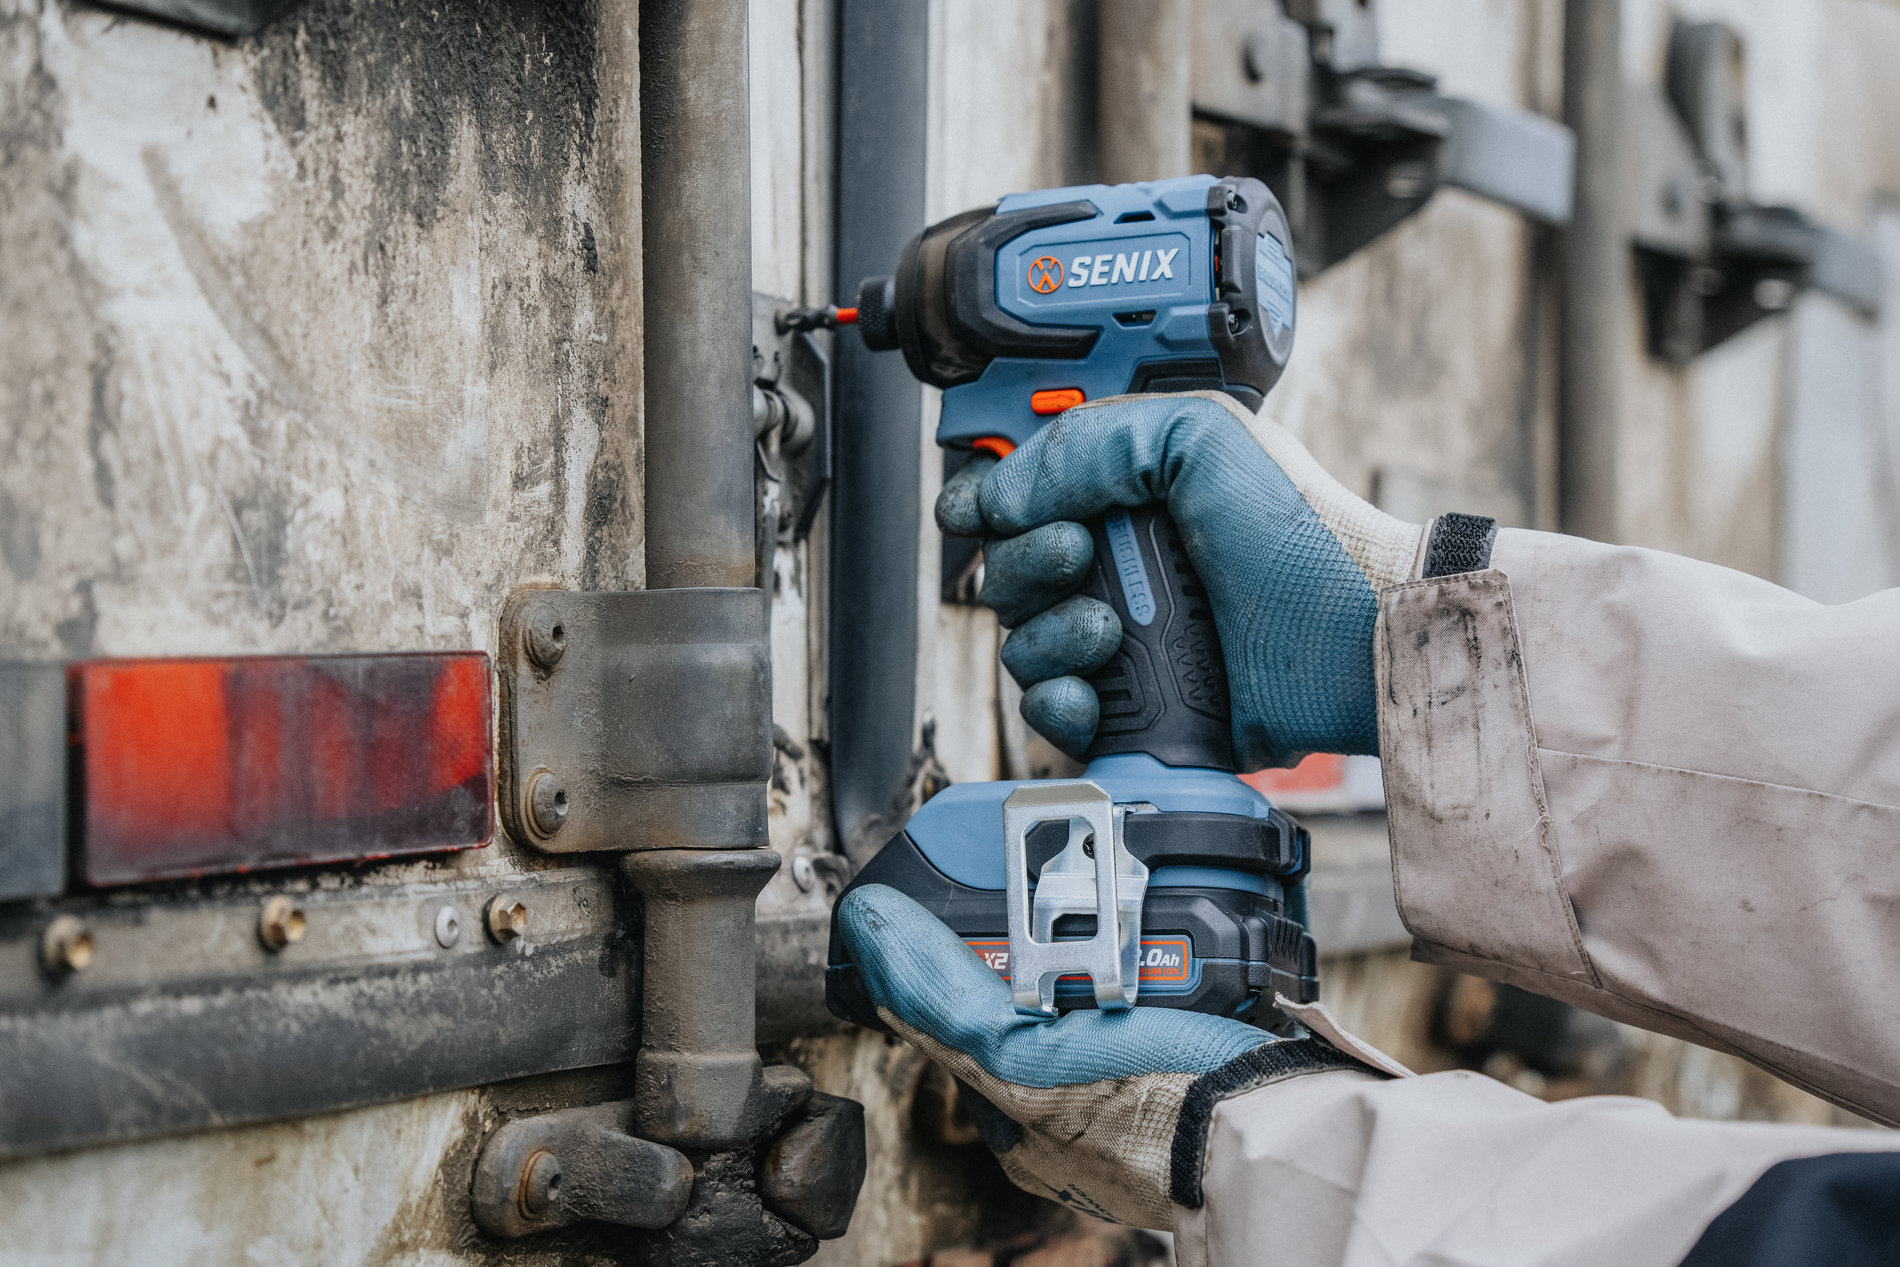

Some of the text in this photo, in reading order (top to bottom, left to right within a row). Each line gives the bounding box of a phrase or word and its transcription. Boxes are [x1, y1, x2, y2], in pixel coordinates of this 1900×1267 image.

[1067, 248, 1180, 288] SENIX
[1139, 948, 1180, 967] .0Ah
[1163, 967, 1180, 975] ION
